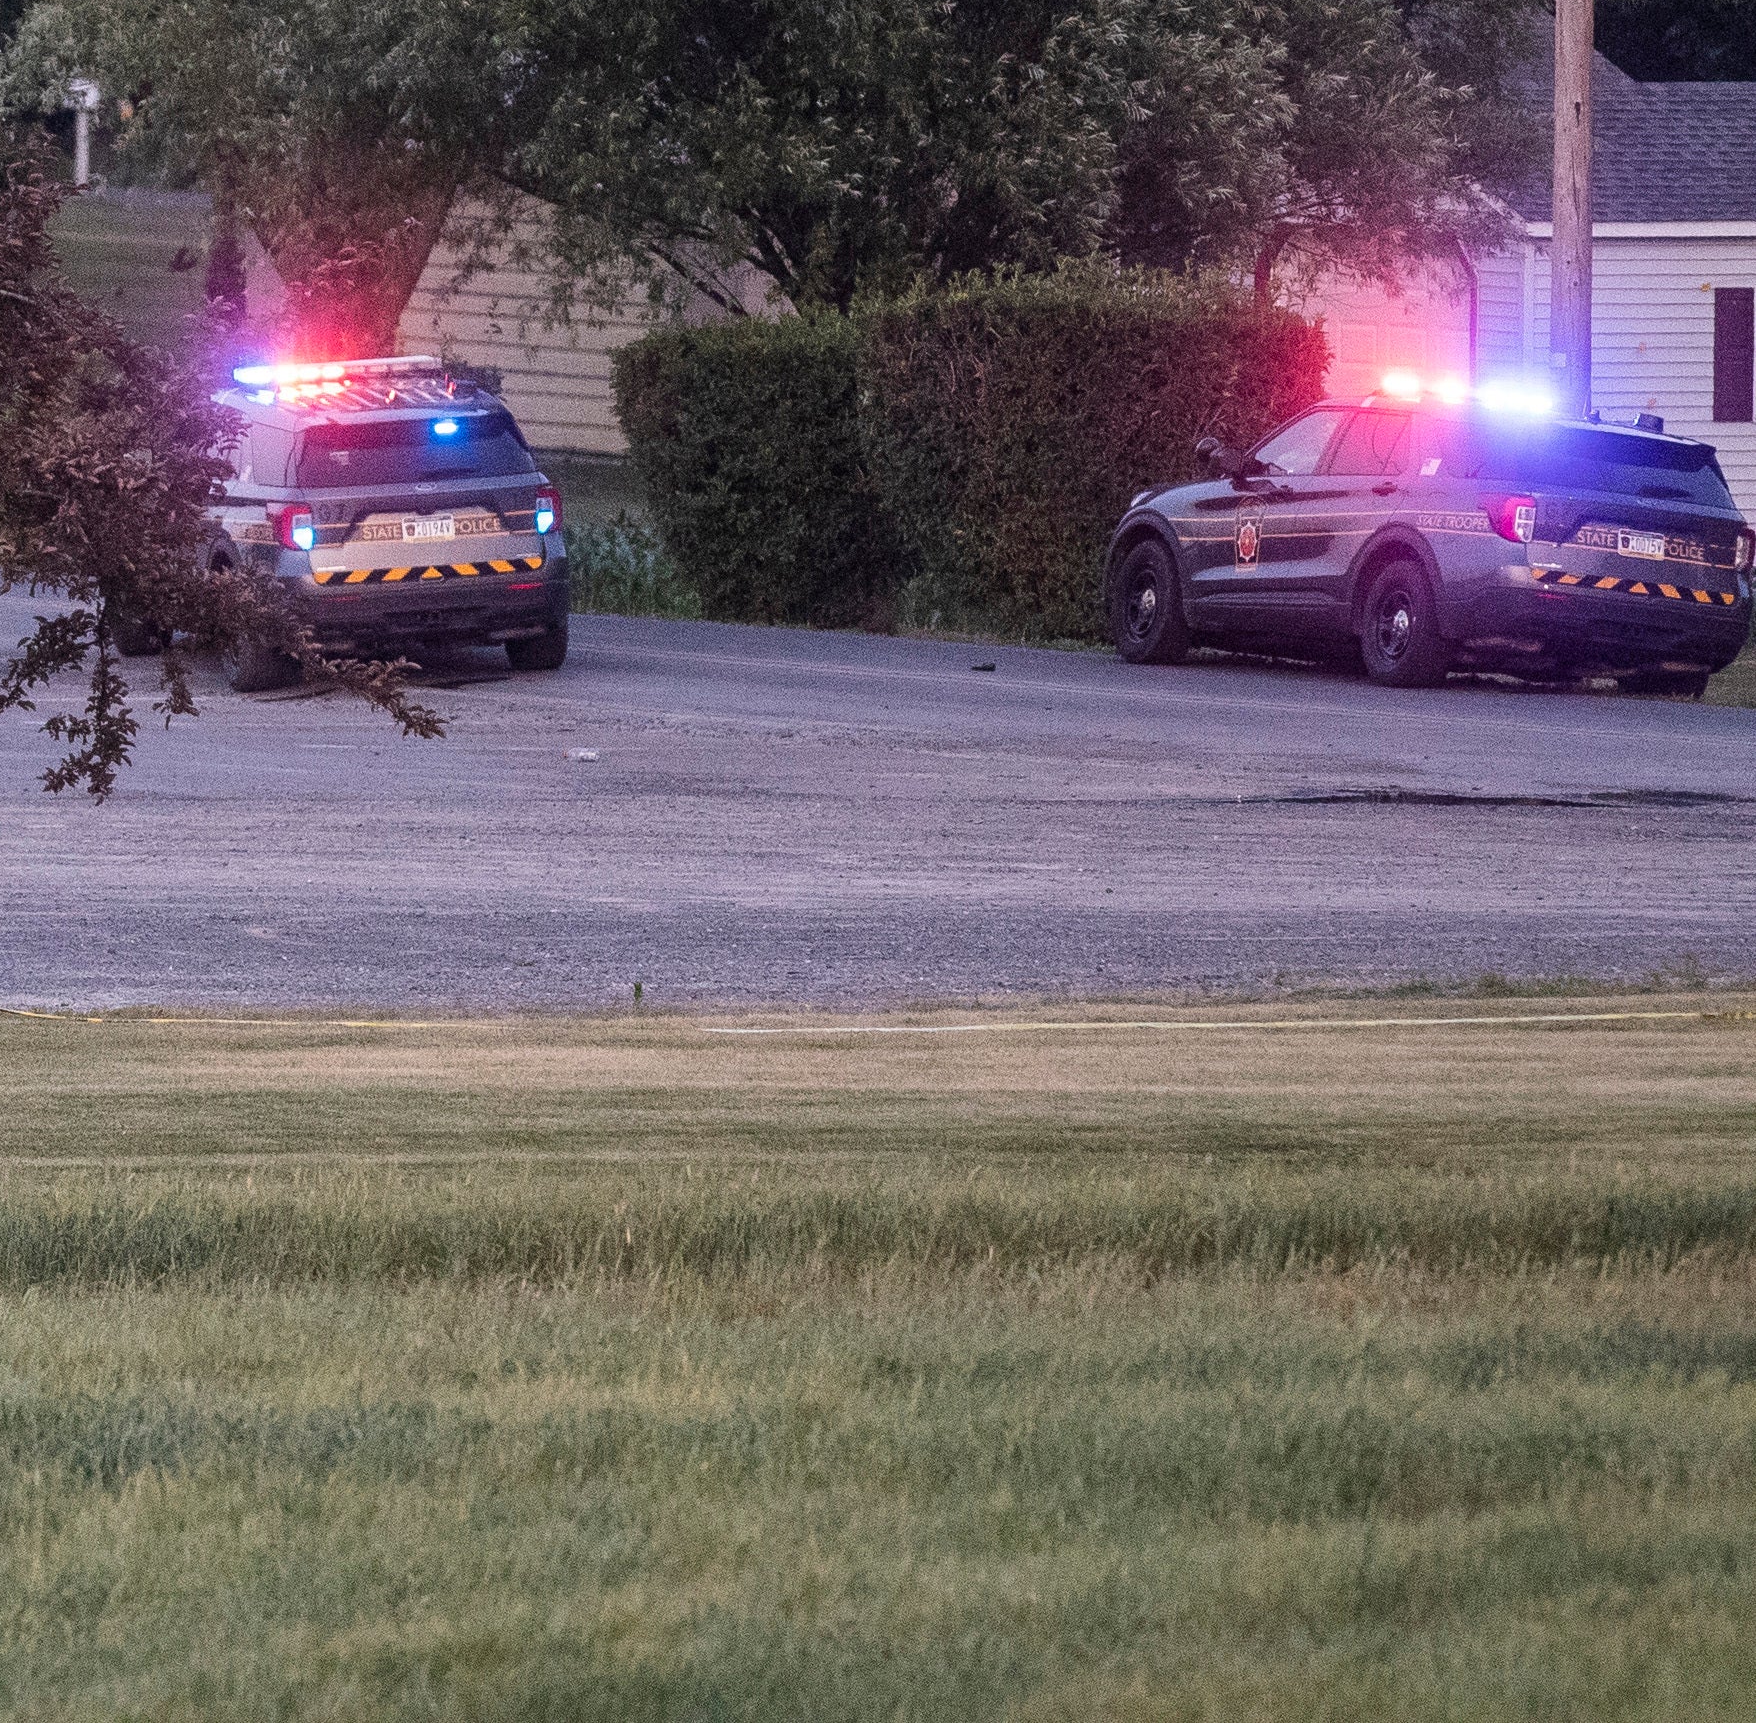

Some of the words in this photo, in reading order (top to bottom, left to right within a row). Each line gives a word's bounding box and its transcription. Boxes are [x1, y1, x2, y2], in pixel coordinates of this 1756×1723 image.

[453, 517, 500, 535] POLICE
[1416, 514, 1443, 527] STATE
[363, 524, 401, 540] STATE
[1577, 531, 1614, 547] STATE
[1664, 543, 1704, 560] POLICE
